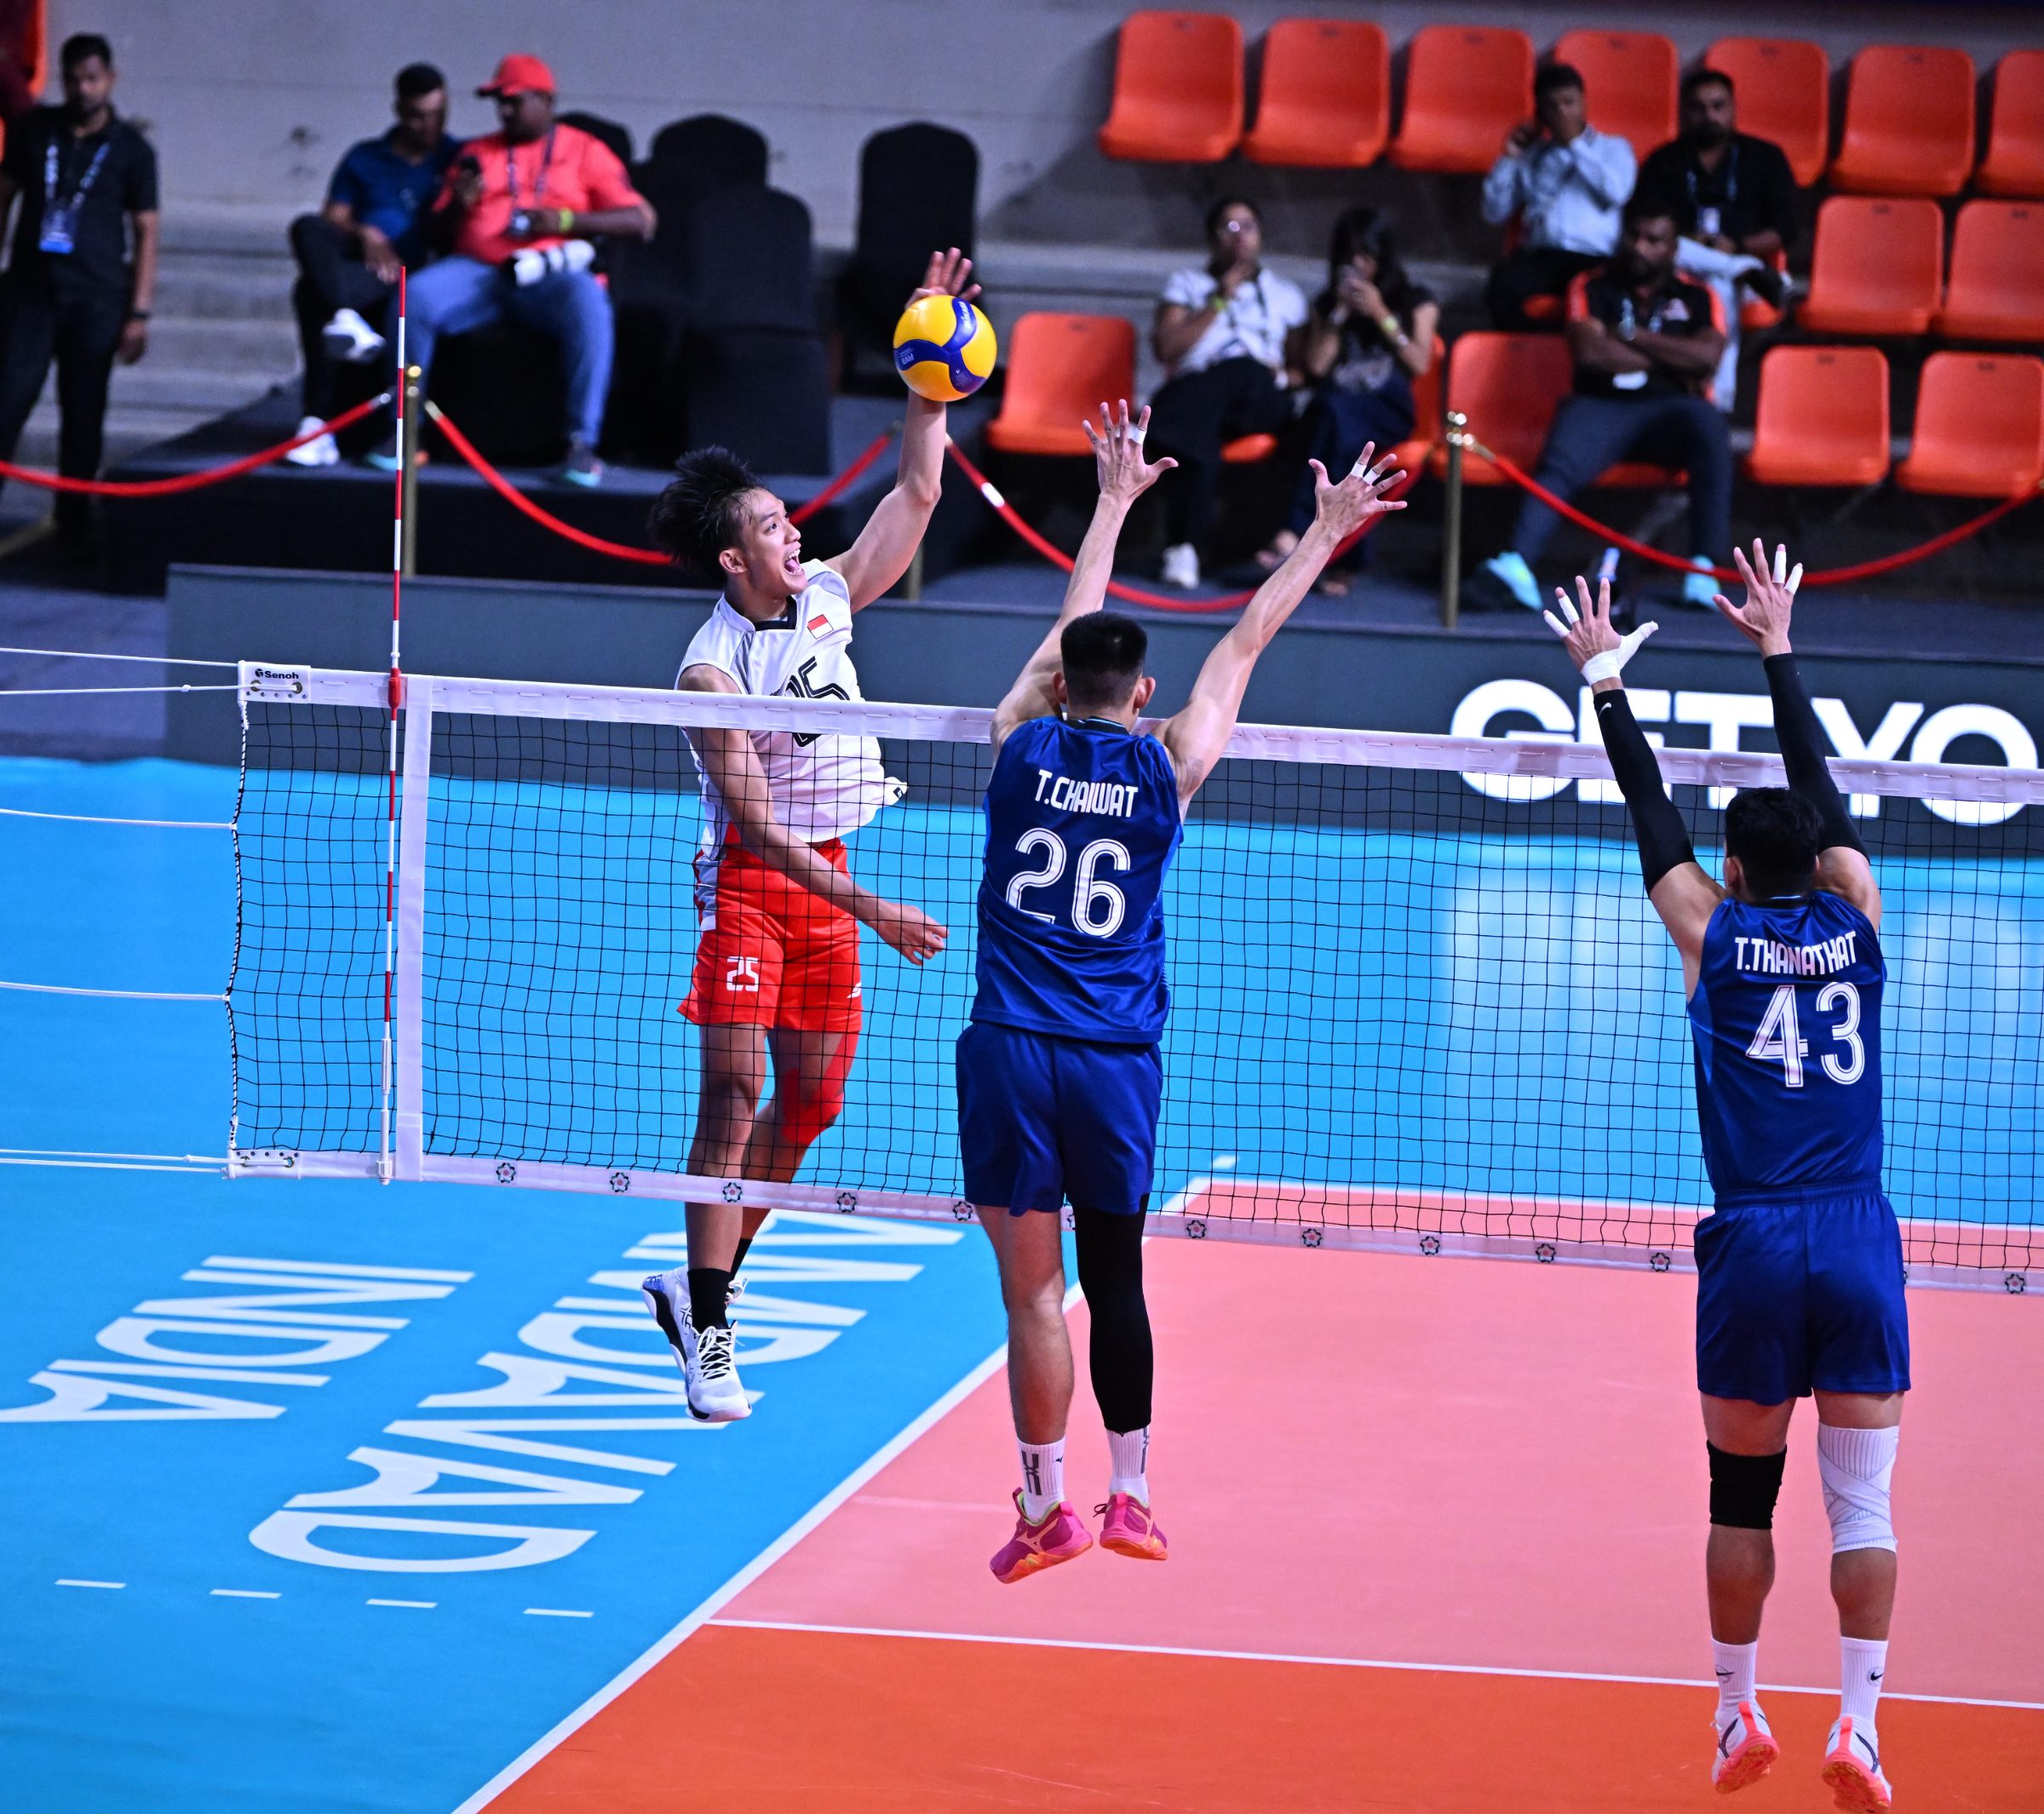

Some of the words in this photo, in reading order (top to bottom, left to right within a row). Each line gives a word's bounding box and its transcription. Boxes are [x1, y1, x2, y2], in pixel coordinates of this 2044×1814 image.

[265, 670, 299, 680] Senoh
[1035, 769, 1139, 818] T.CHAIWAT
[1005, 827, 1131, 939] 26
[726, 956, 759, 992] 25
[1735, 931, 1857, 976] T.THANATHAT
[1746, 982, 1865, 1088] 43
[0, 1255, 476, 1422] INDIA
